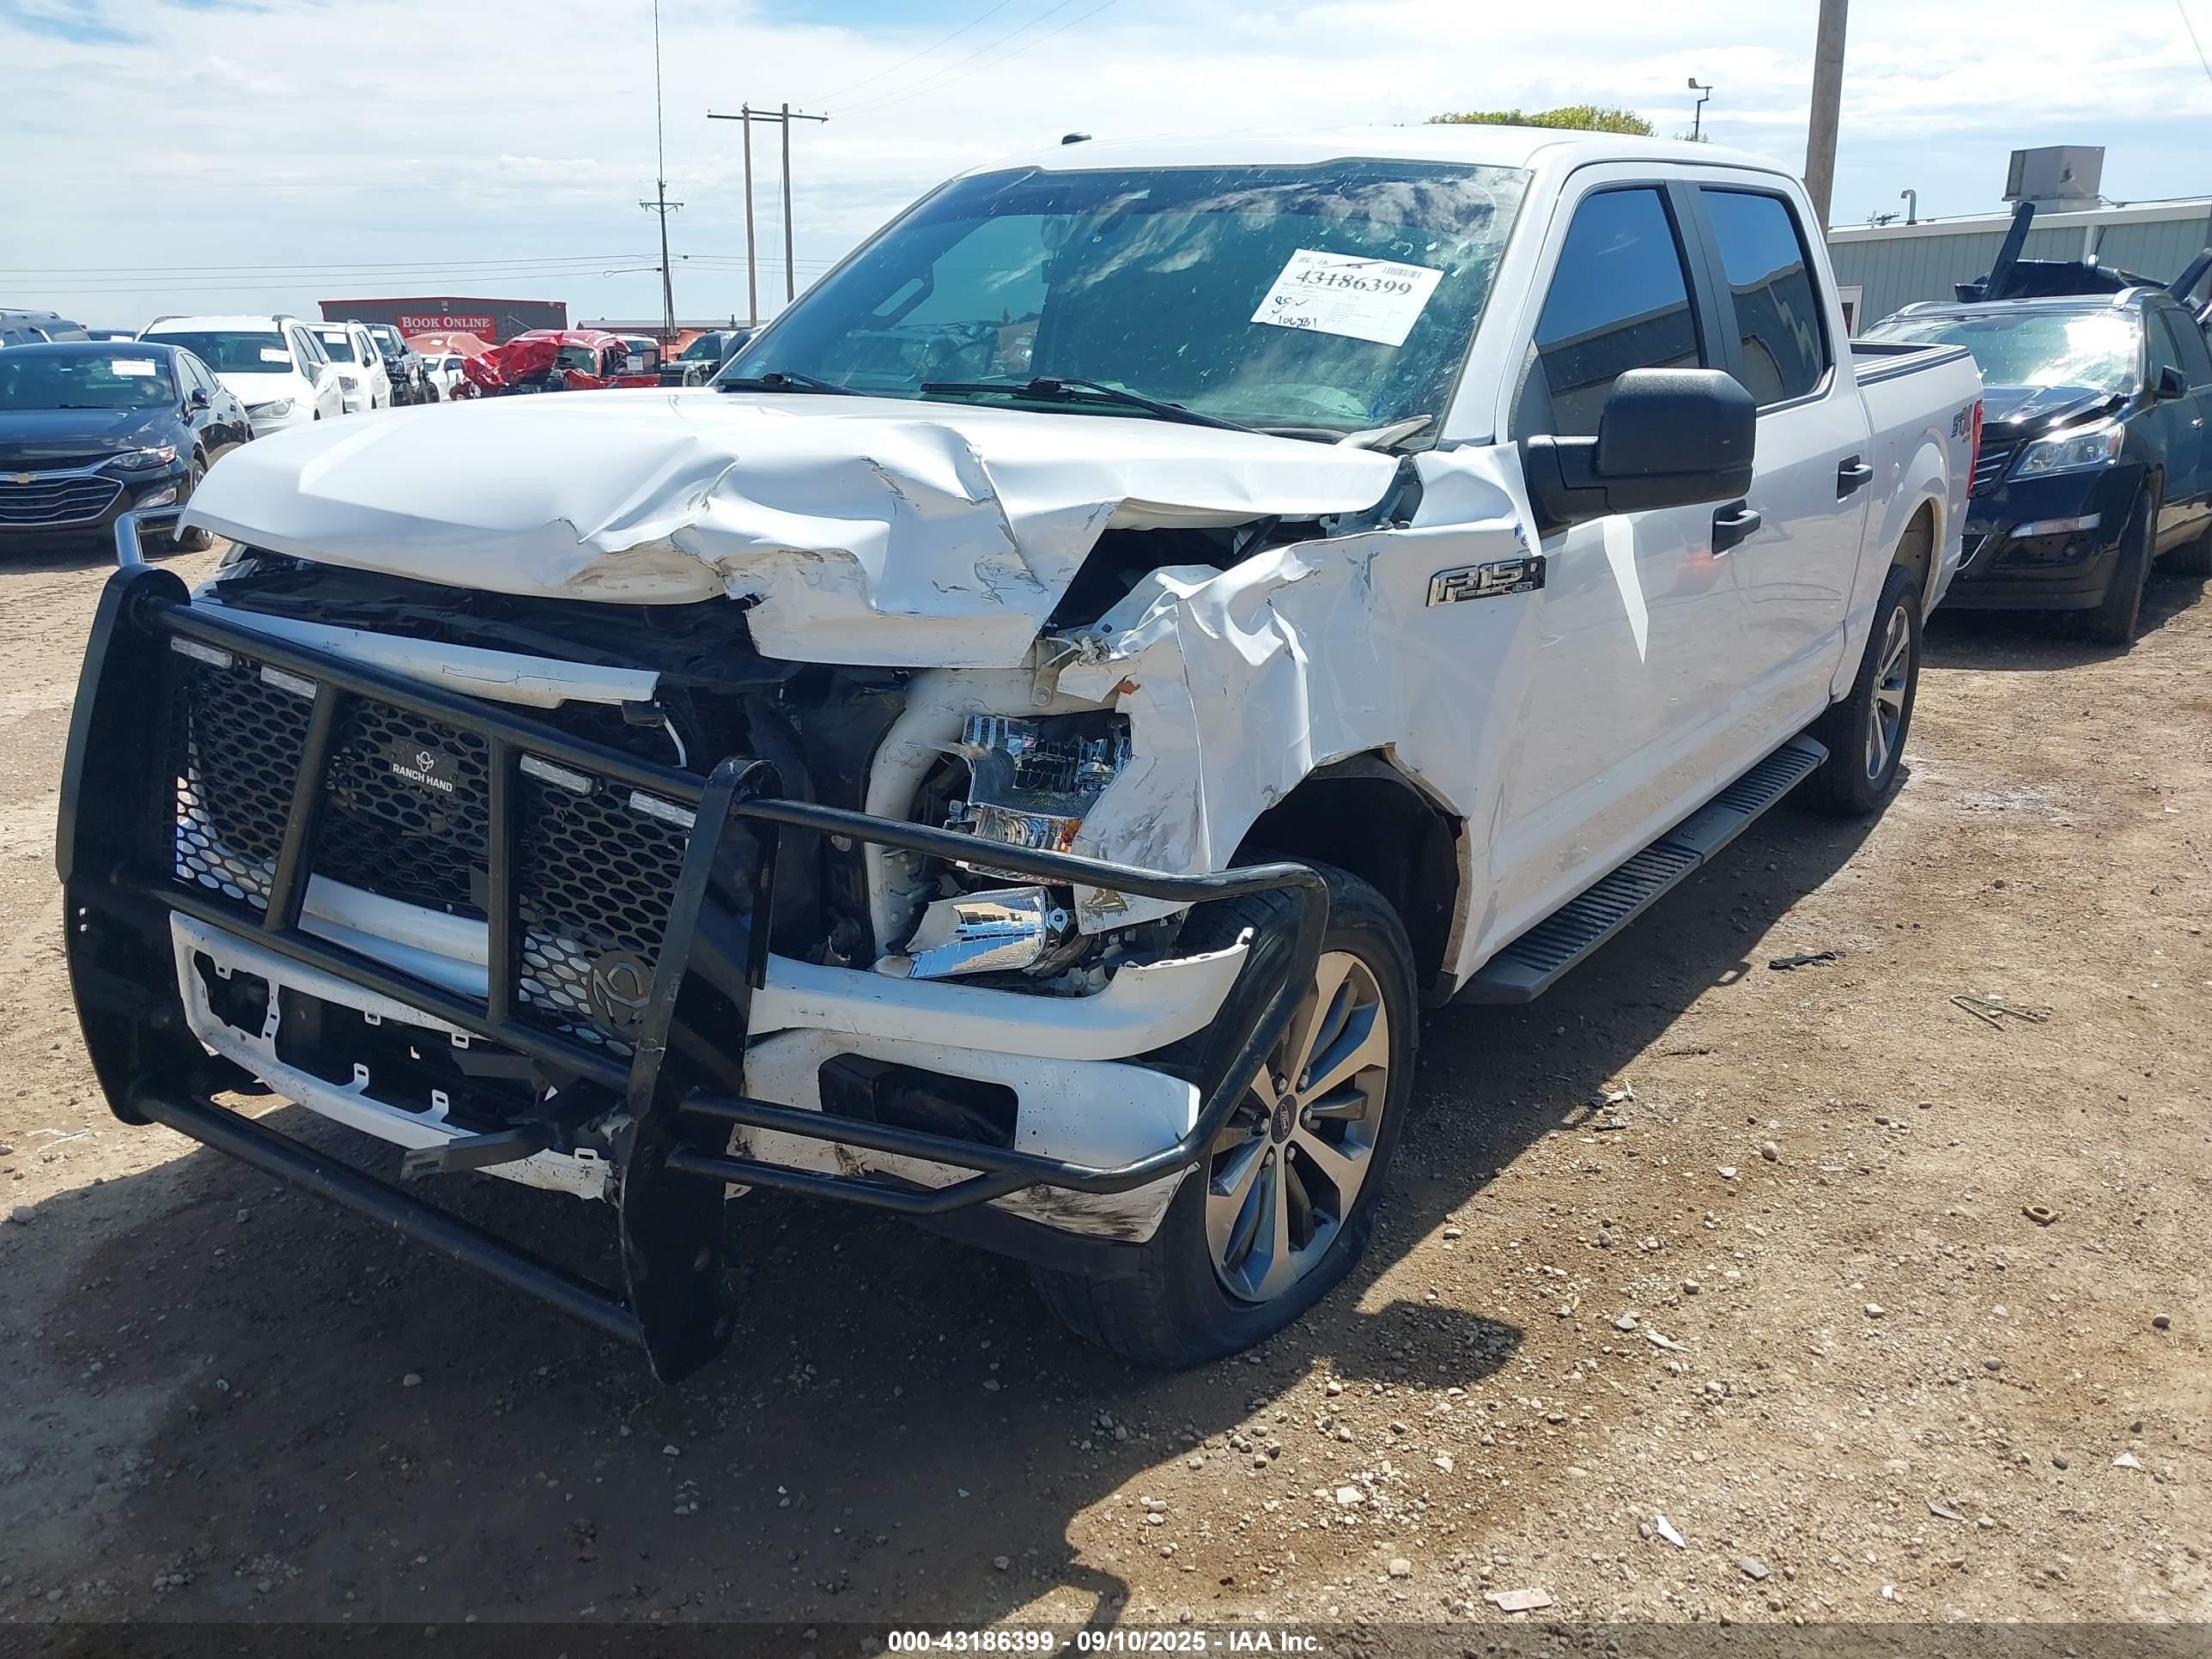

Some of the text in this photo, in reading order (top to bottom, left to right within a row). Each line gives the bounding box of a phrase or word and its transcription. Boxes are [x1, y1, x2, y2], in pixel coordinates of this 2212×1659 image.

[1296, 269, 1413, 296] 43186399
[402, 317, 490, 327] BOOK ONLINE
[392, 763, 453, 793] RANCH HAND
